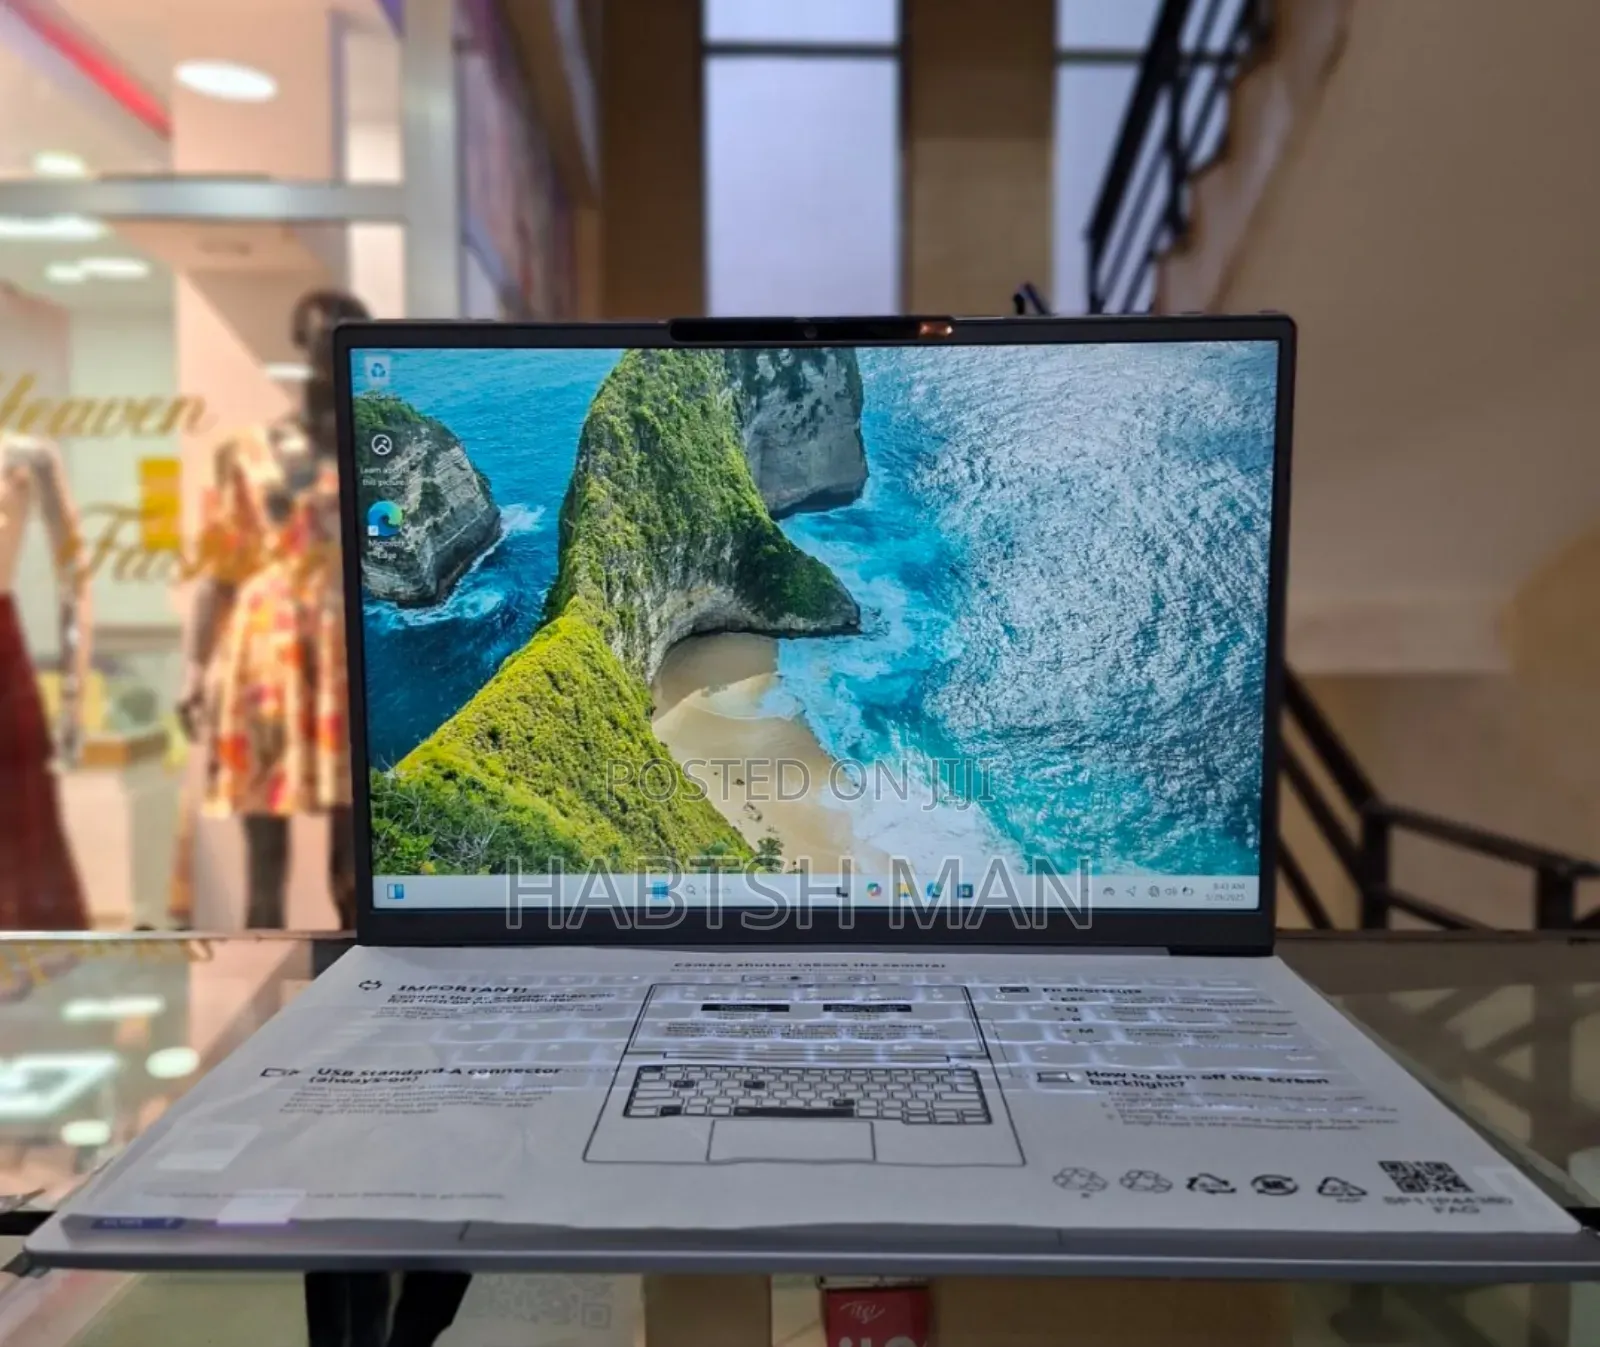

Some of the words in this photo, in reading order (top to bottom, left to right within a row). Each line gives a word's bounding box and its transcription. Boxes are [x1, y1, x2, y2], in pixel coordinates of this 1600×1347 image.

[1085, 1070, 1127, 1079] How
[1132, 1072, 1152, 1080] to
[1155, 1072, 1196, 1081] turn
[1201, 1073, 1227, 1082] off
[1267, 1076, 1331, 1085] screen
